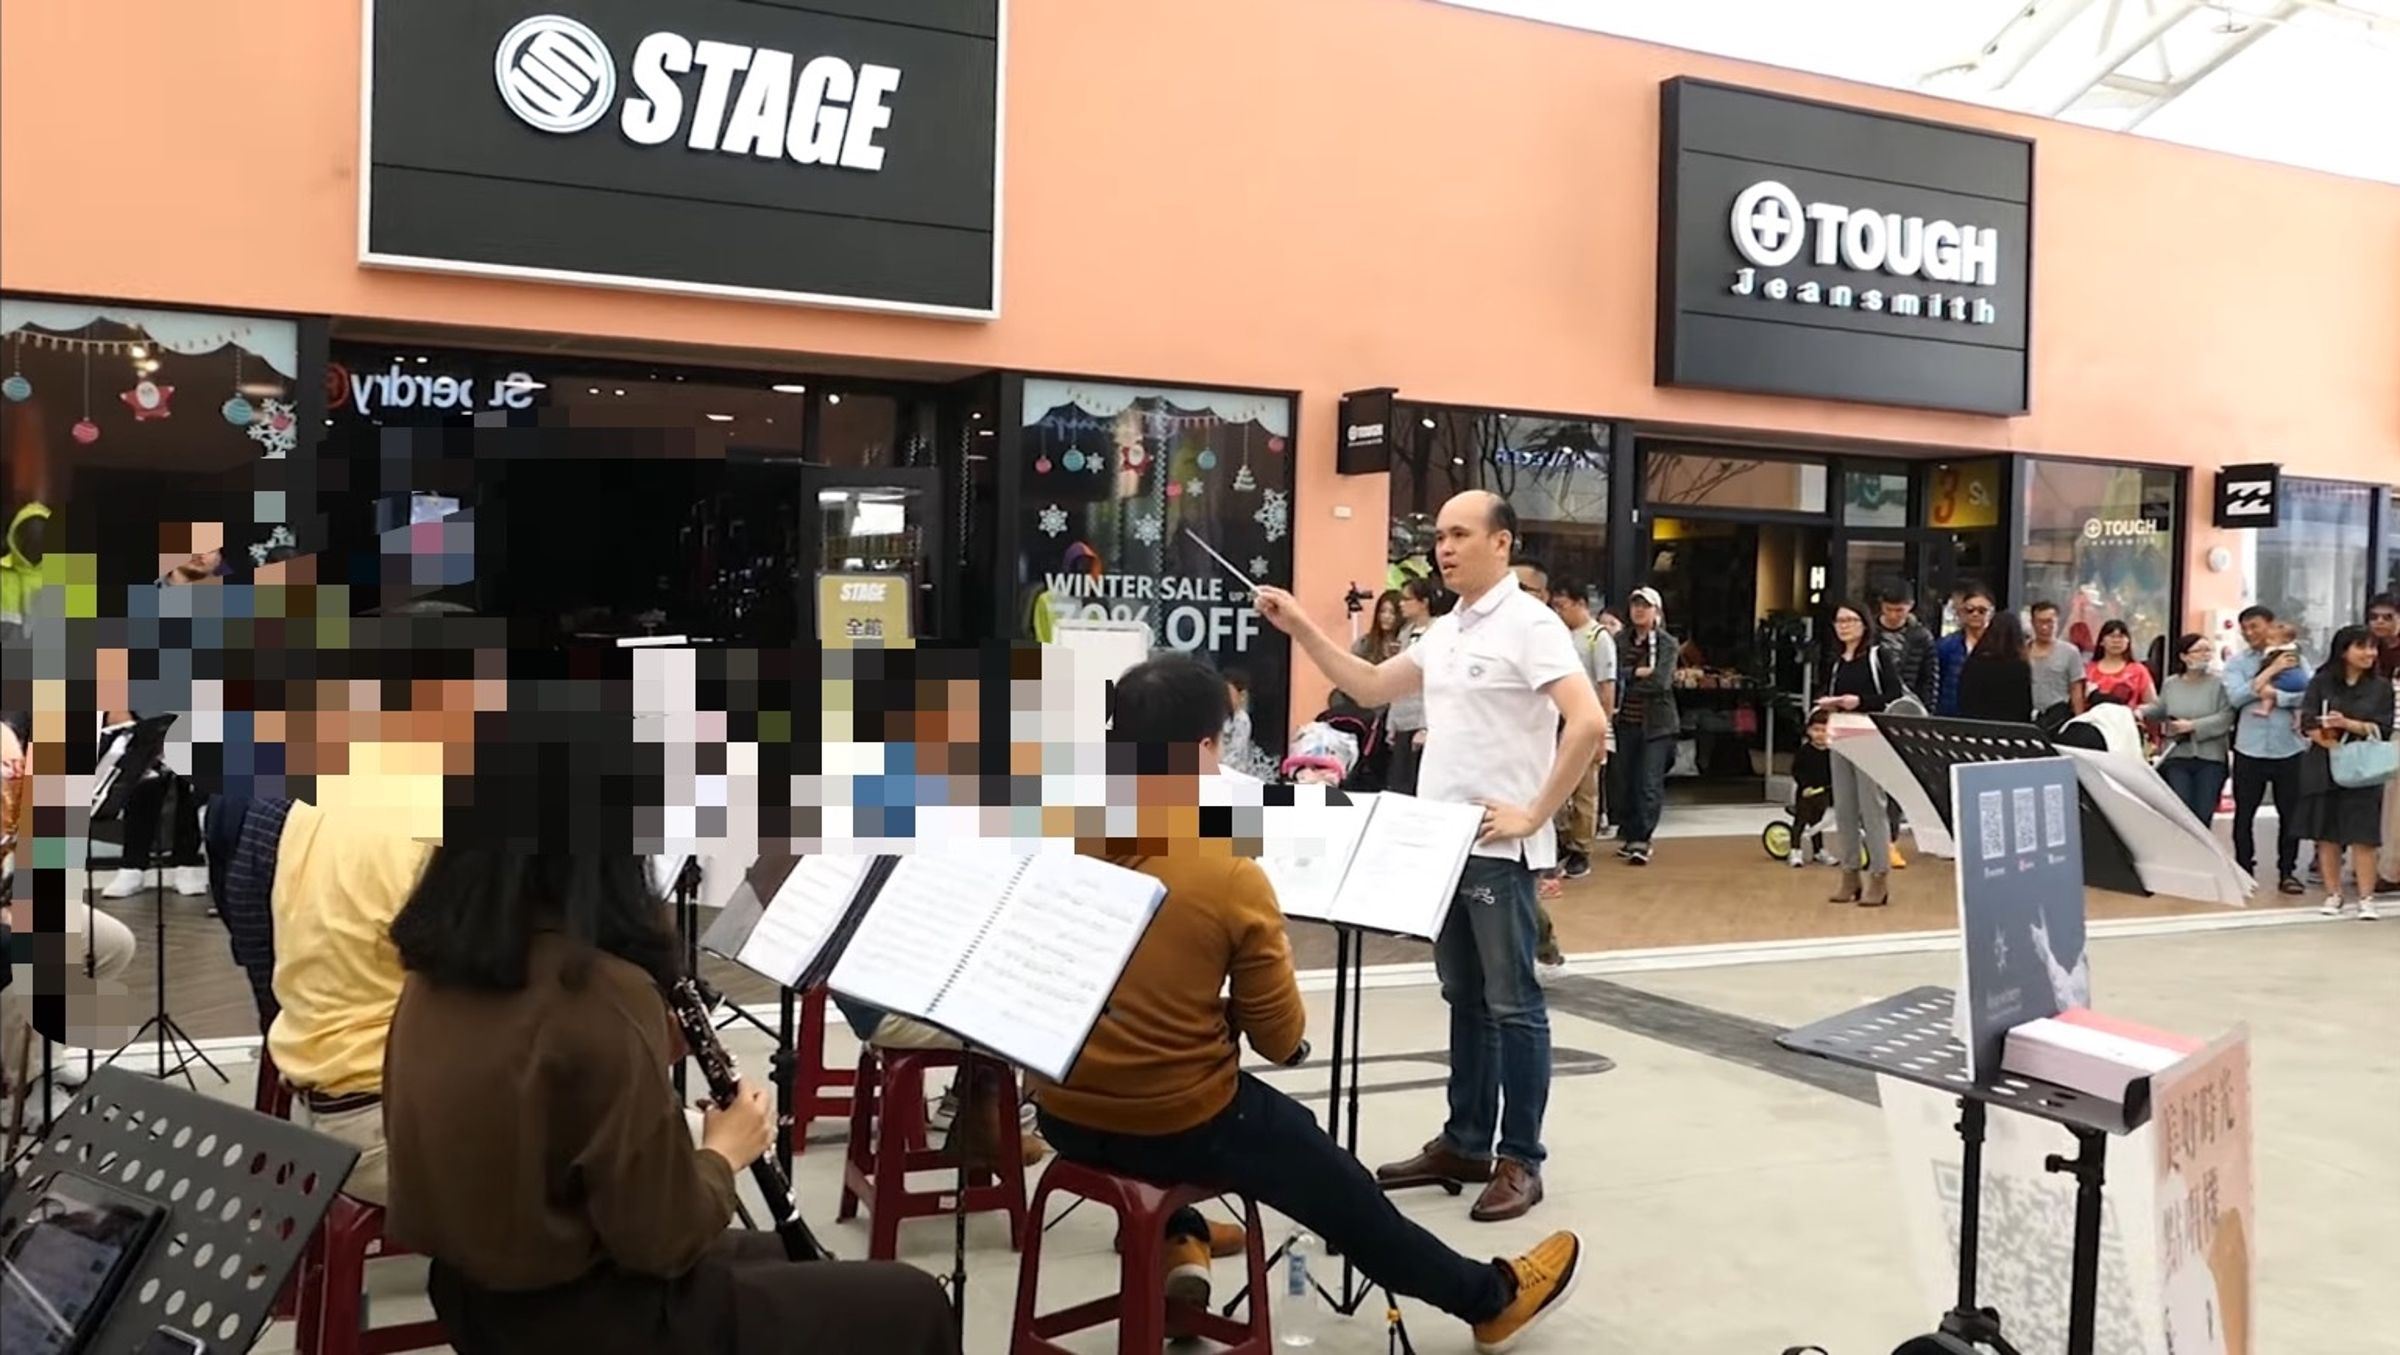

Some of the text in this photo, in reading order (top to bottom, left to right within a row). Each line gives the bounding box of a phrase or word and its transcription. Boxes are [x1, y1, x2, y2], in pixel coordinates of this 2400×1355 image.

[621, 32, 902, 172] STAGE
[1806, 202, 1997, 286] TOUGH
[1729, 267, 1996, 325] Jeansmith
[2103, 518, 2158, 537] TOUGH
[840, 582, 889, 602] STAGE
[1044, 572, 1154, 599] WINTER
[1160, 577, 1223, 601] SALE
[1166, 606, 1261, 652] OFF
